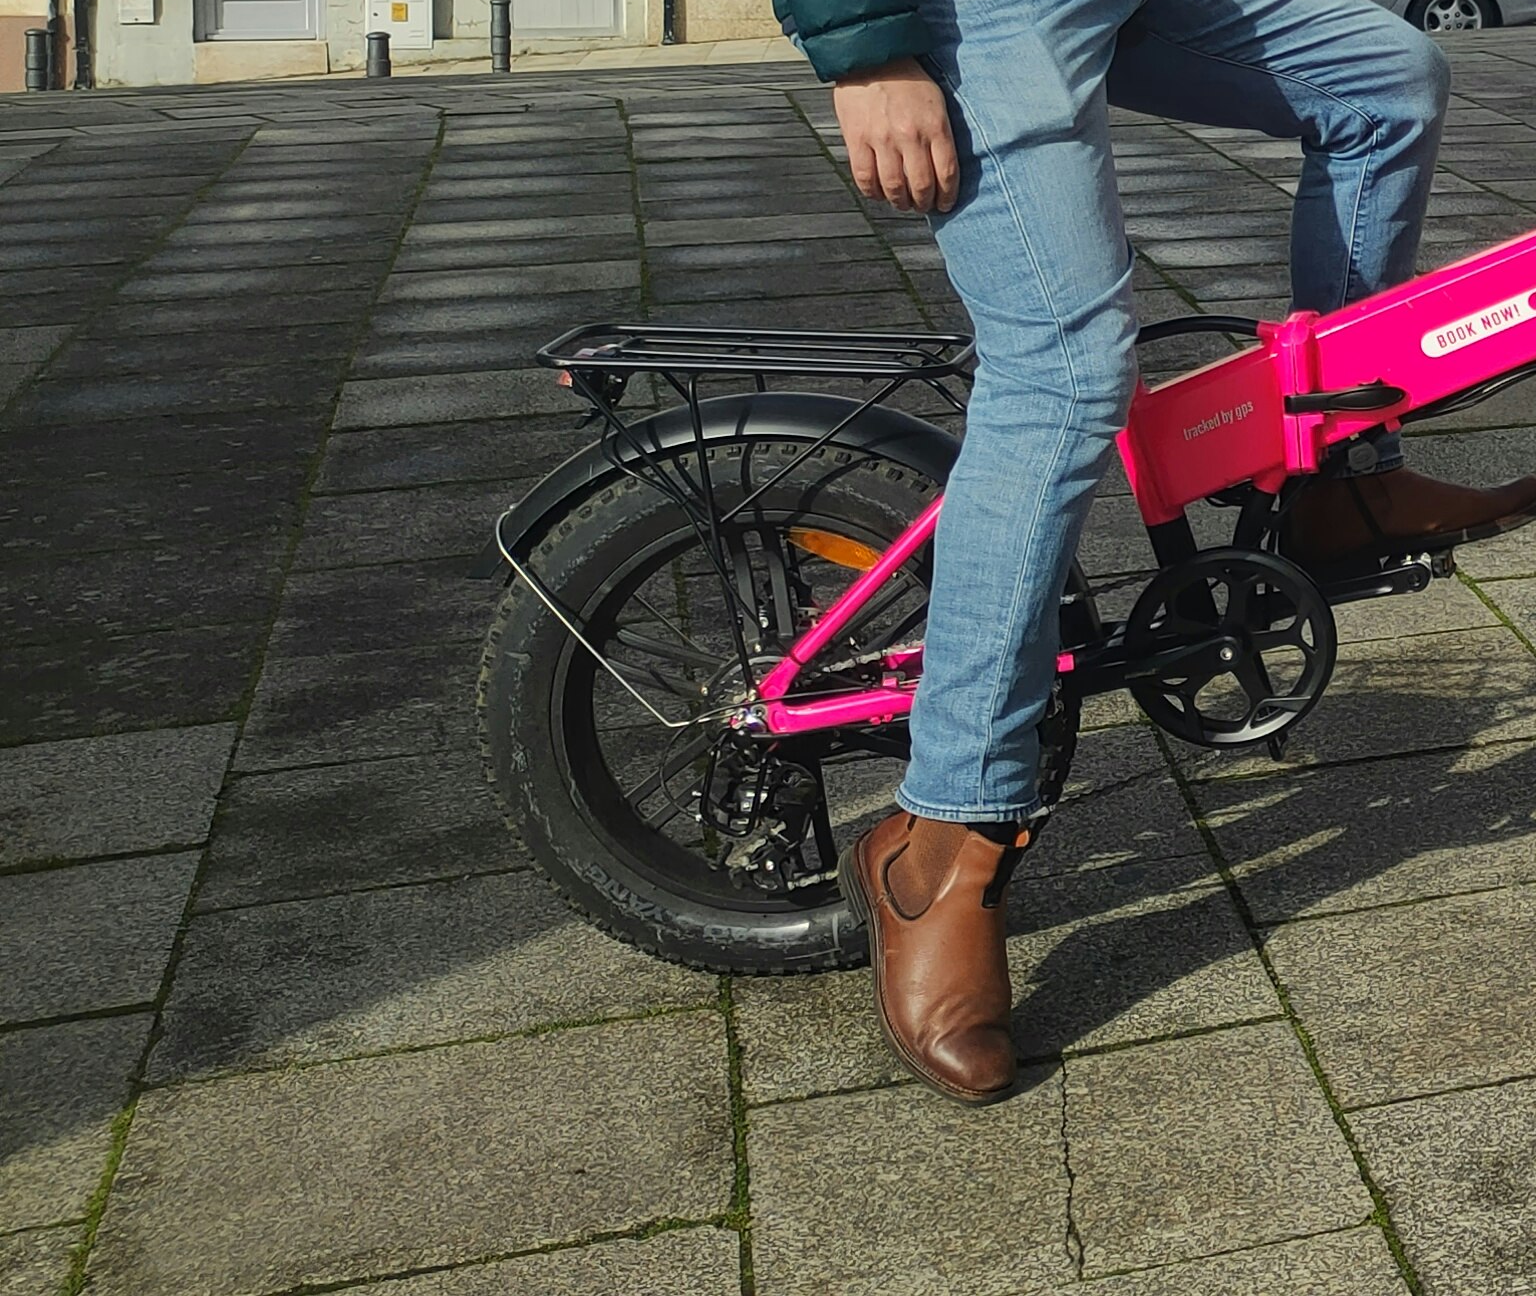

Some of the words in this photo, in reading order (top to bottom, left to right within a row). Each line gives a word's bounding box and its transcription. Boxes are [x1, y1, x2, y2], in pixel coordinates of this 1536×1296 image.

[1436, 322, 1477, 349] BOOK
[1481, 304, 1521, 331] NOW!
[1183, 412, 1221, 441] tracked
[1220, 410, 1234, 424] by
[1235, 401, 1254, 421] gps
